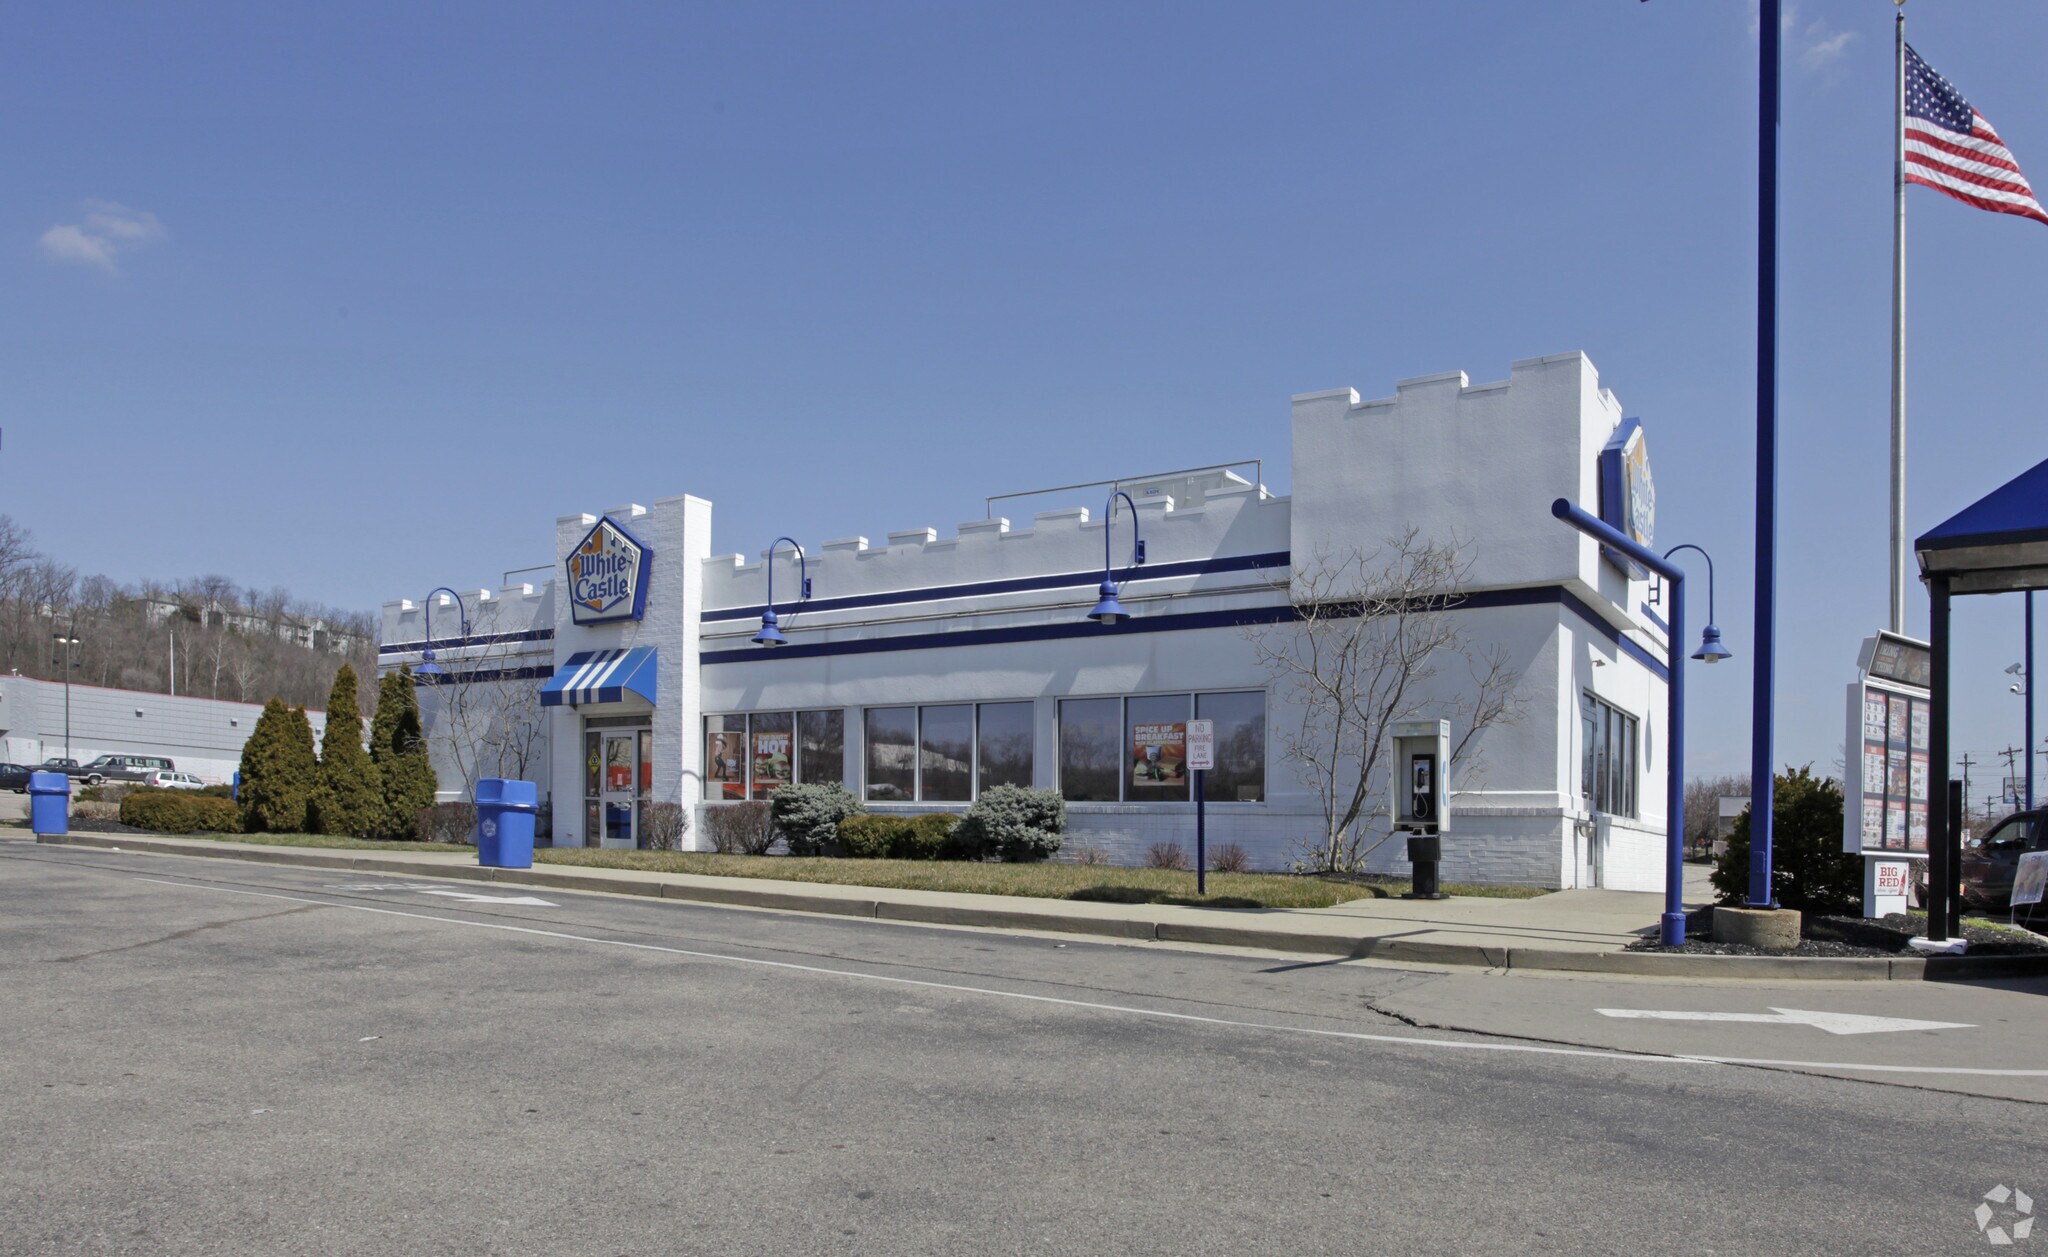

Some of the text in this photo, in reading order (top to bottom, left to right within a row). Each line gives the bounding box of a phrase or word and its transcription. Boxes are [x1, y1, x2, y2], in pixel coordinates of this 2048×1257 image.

[578, 552, 627, 580] White
[575, 574, 629, 602] Castle
[1135, 726, 1159, 734] SPICE
[1194, 723, 1205, 733] NO
[1135, 732, 1184, 741] BREAKFAST
[1188, 733, 1212, 743] PARKING
[757, 739, 789, 754] HOT
[1194, 744, 1206, 752] FIRE
[1192, 752, 1207, 760] LANE
[1880, 866, 1898, 877] BIG
[1879, 877, 1900, 887] RED
